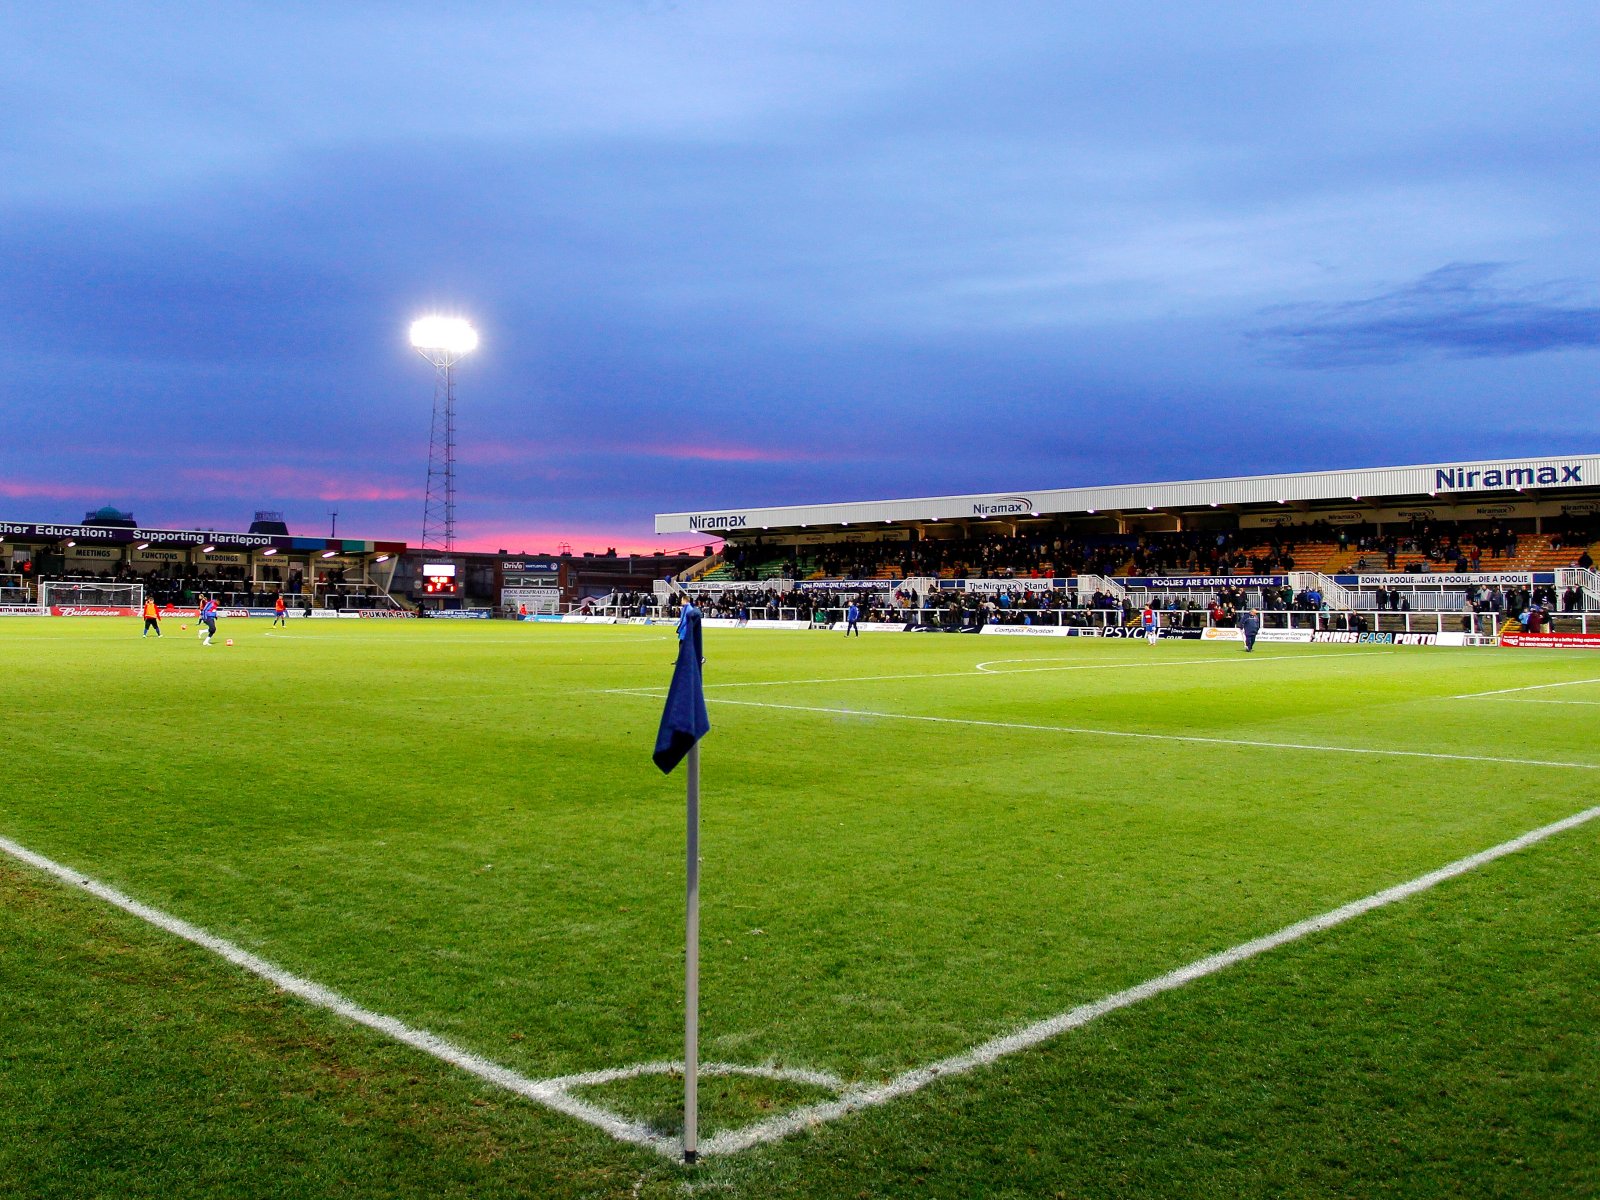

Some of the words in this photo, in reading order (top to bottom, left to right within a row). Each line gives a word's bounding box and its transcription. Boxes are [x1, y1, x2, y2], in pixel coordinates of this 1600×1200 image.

[1436, 465, 1582, 489] Niramax
[973, 504, 1022, 514] Niramax
[689, 515, 746, 528] Niramax
[35, 525, 113, 538] Education:
[133, 529, 205, 544] Supporting
[209, 533, 272, 546] Hartlepool
[76, 549, 111, 557] MEETINGS
[141, 552, 178, 560] FUNCTIONS
[59, 607, 120, 616] Budweiser
[1026, 627, 1054, 635] Royston
[1103, 627, 1168, 639] PSYCE
[1359, 632, 1393, 644] CASA
[1394, 633, 1437, 645] PORTO
